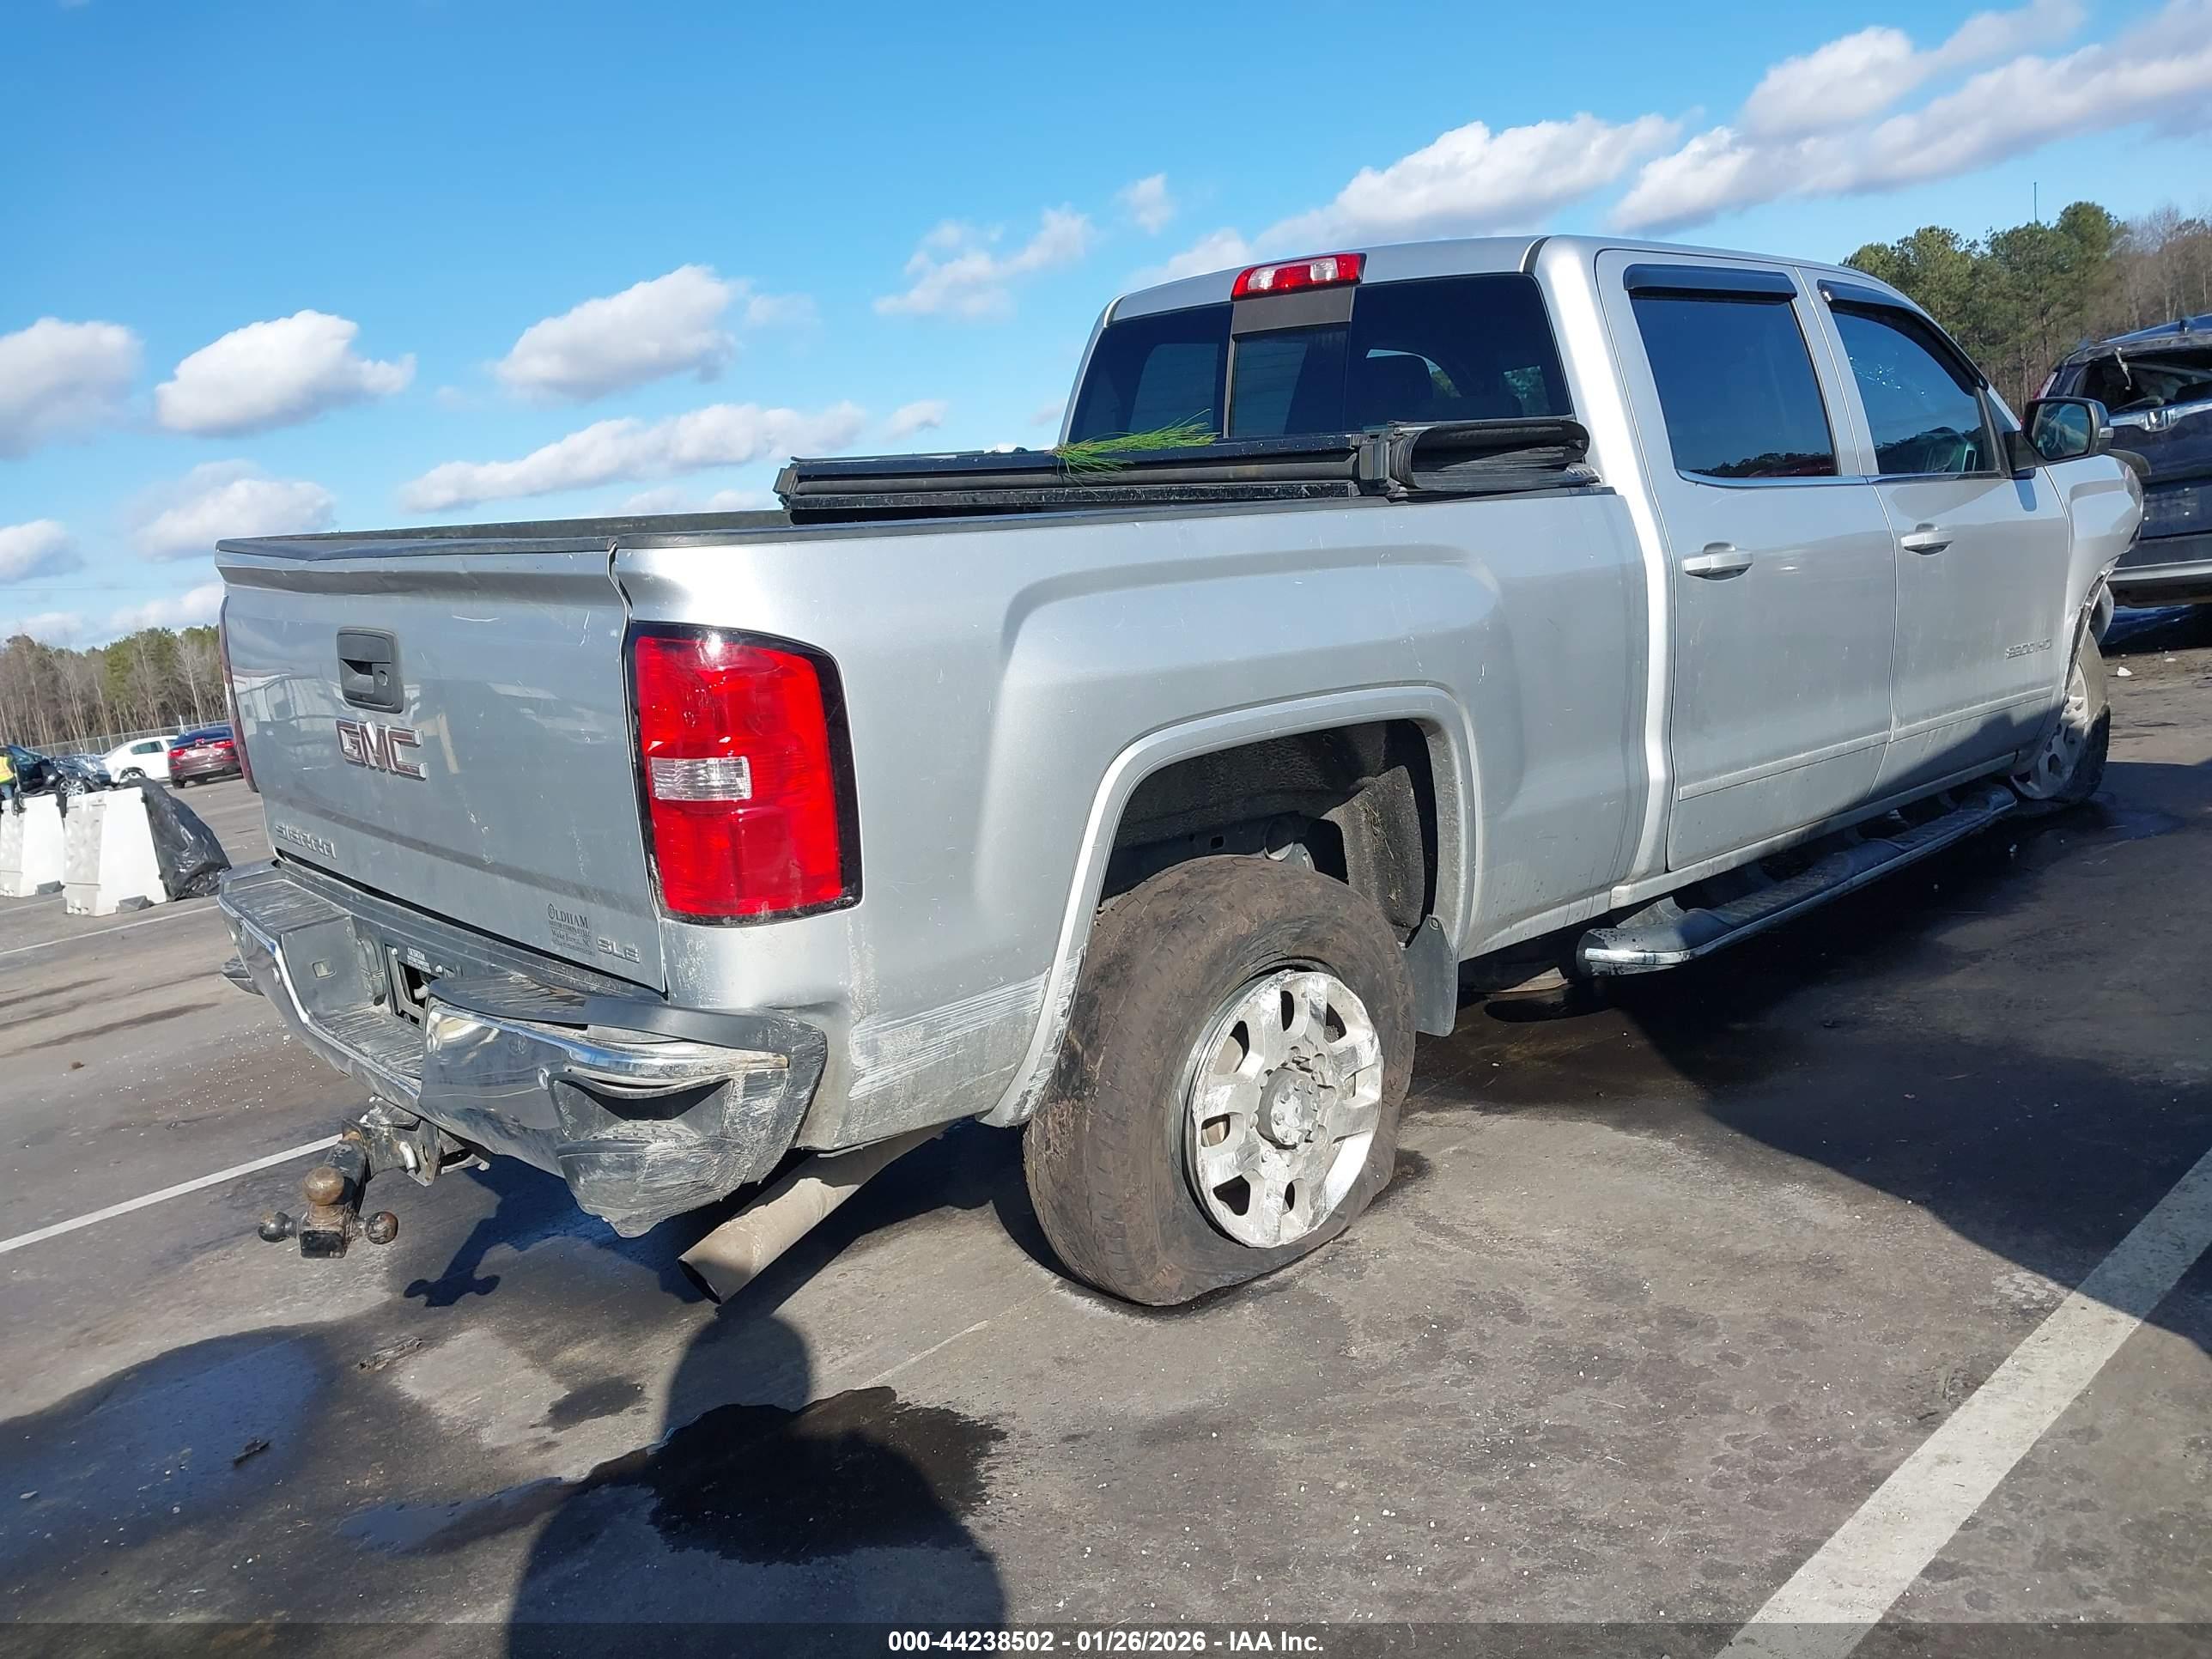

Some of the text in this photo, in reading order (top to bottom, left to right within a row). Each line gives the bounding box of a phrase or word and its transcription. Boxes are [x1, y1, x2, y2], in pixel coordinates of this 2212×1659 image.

[334, 720, 427, 781] GMC
[275, 823, 337, 860] SIERRA
[548, 903, 589, 928] OLDHAM
[597, 936, 641, 963] SLE
